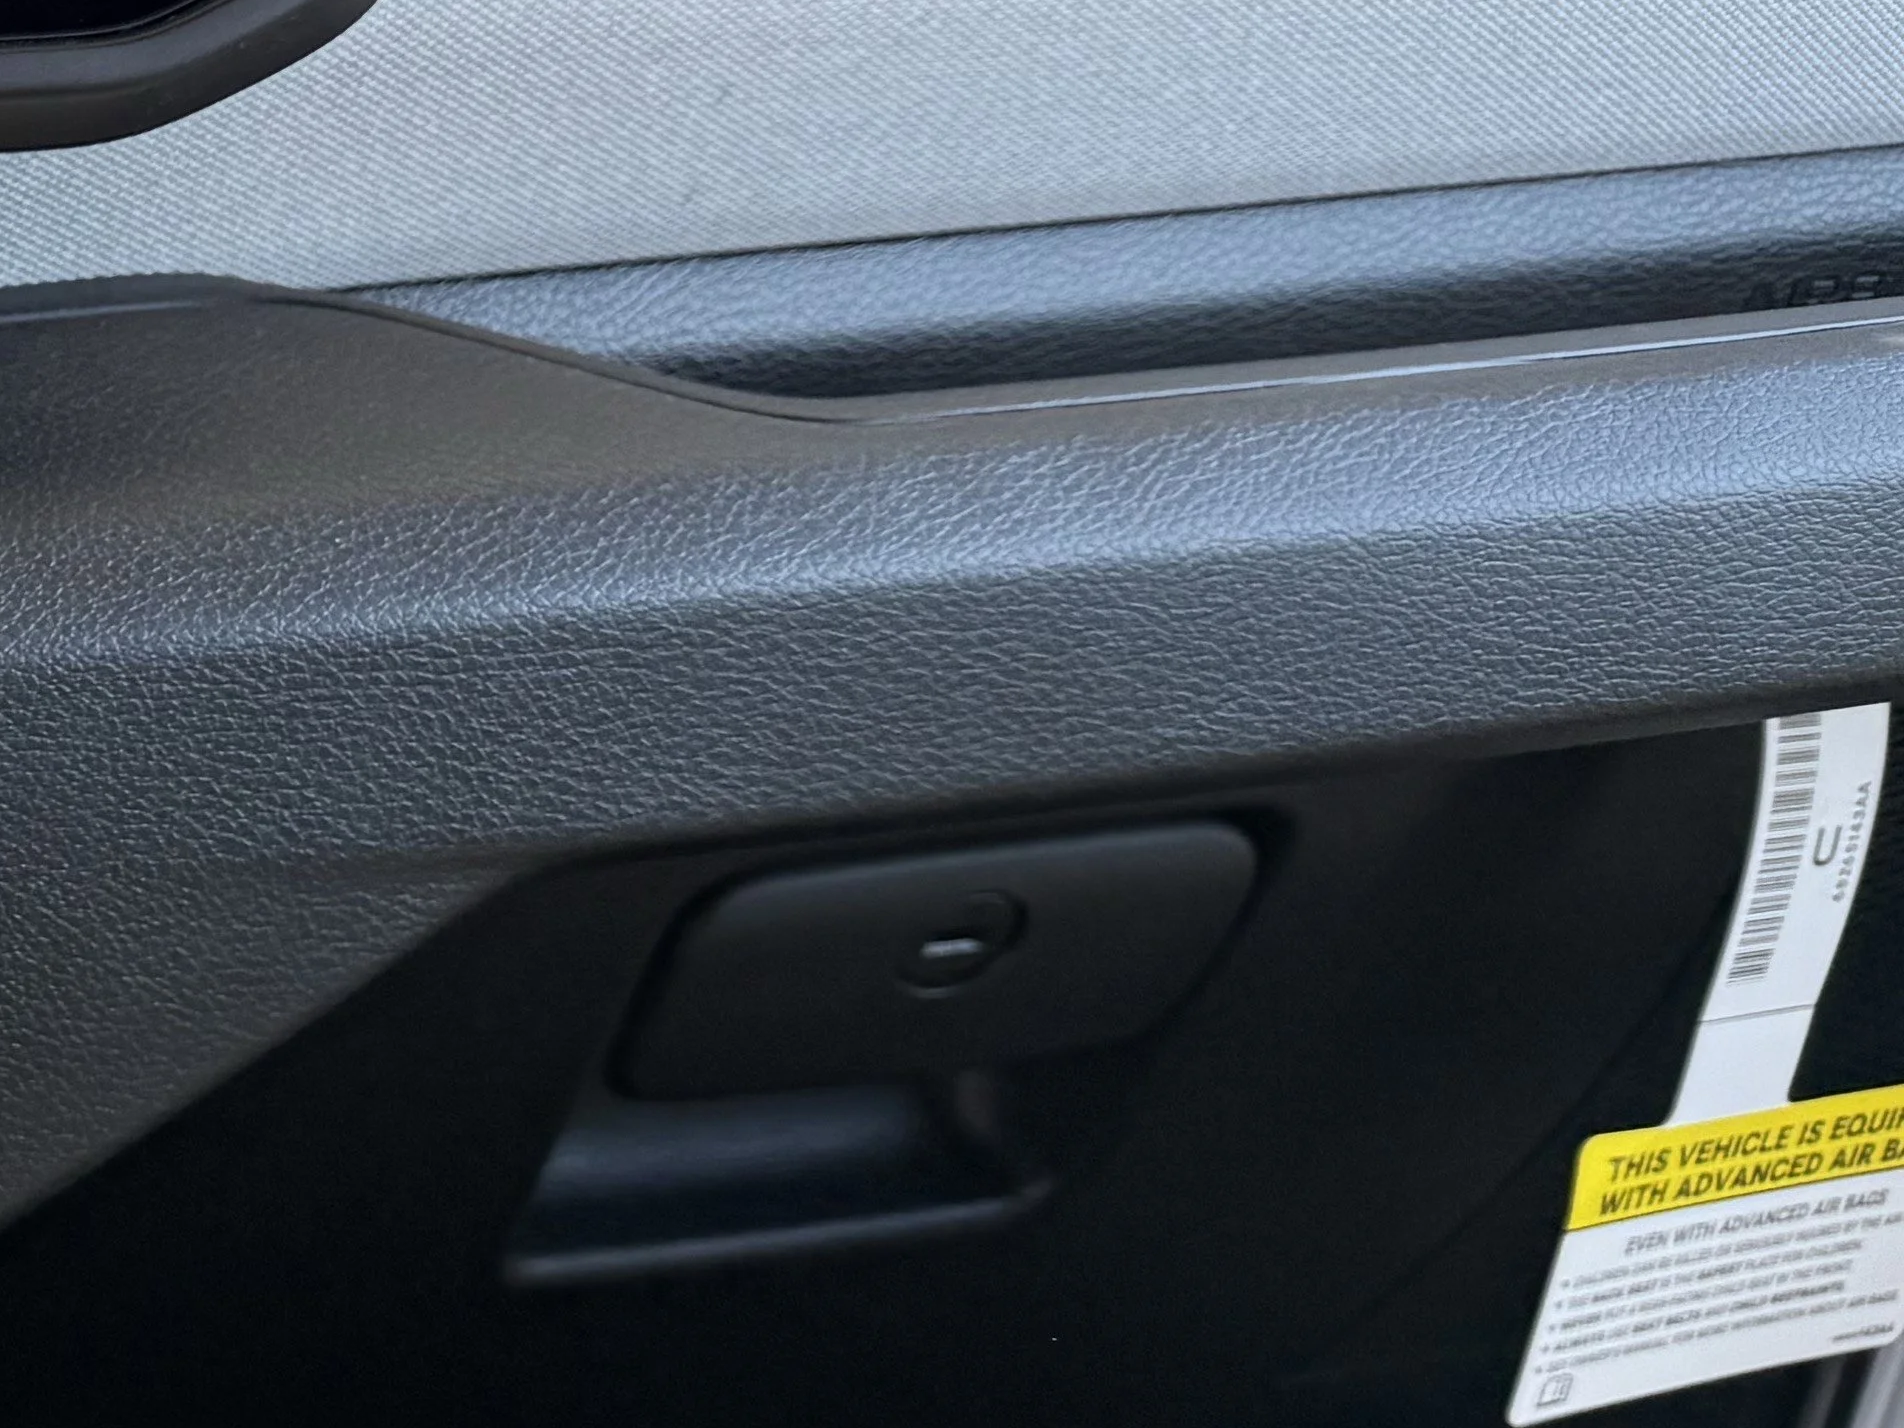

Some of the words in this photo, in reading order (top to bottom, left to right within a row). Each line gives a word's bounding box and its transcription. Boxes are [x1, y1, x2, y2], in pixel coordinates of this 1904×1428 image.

[1599, 1184, 1666, 1215] WITH
[1676, 1152, 1824, 1199] ADVANCED
[1828, 1142, 1876, 1170] AIR
[1608, 1152, 1671, 1183] THIS
[1679, 1126, 1792, 1168] VEHICLE
[1797, 1120, 1826, 1145] IS
